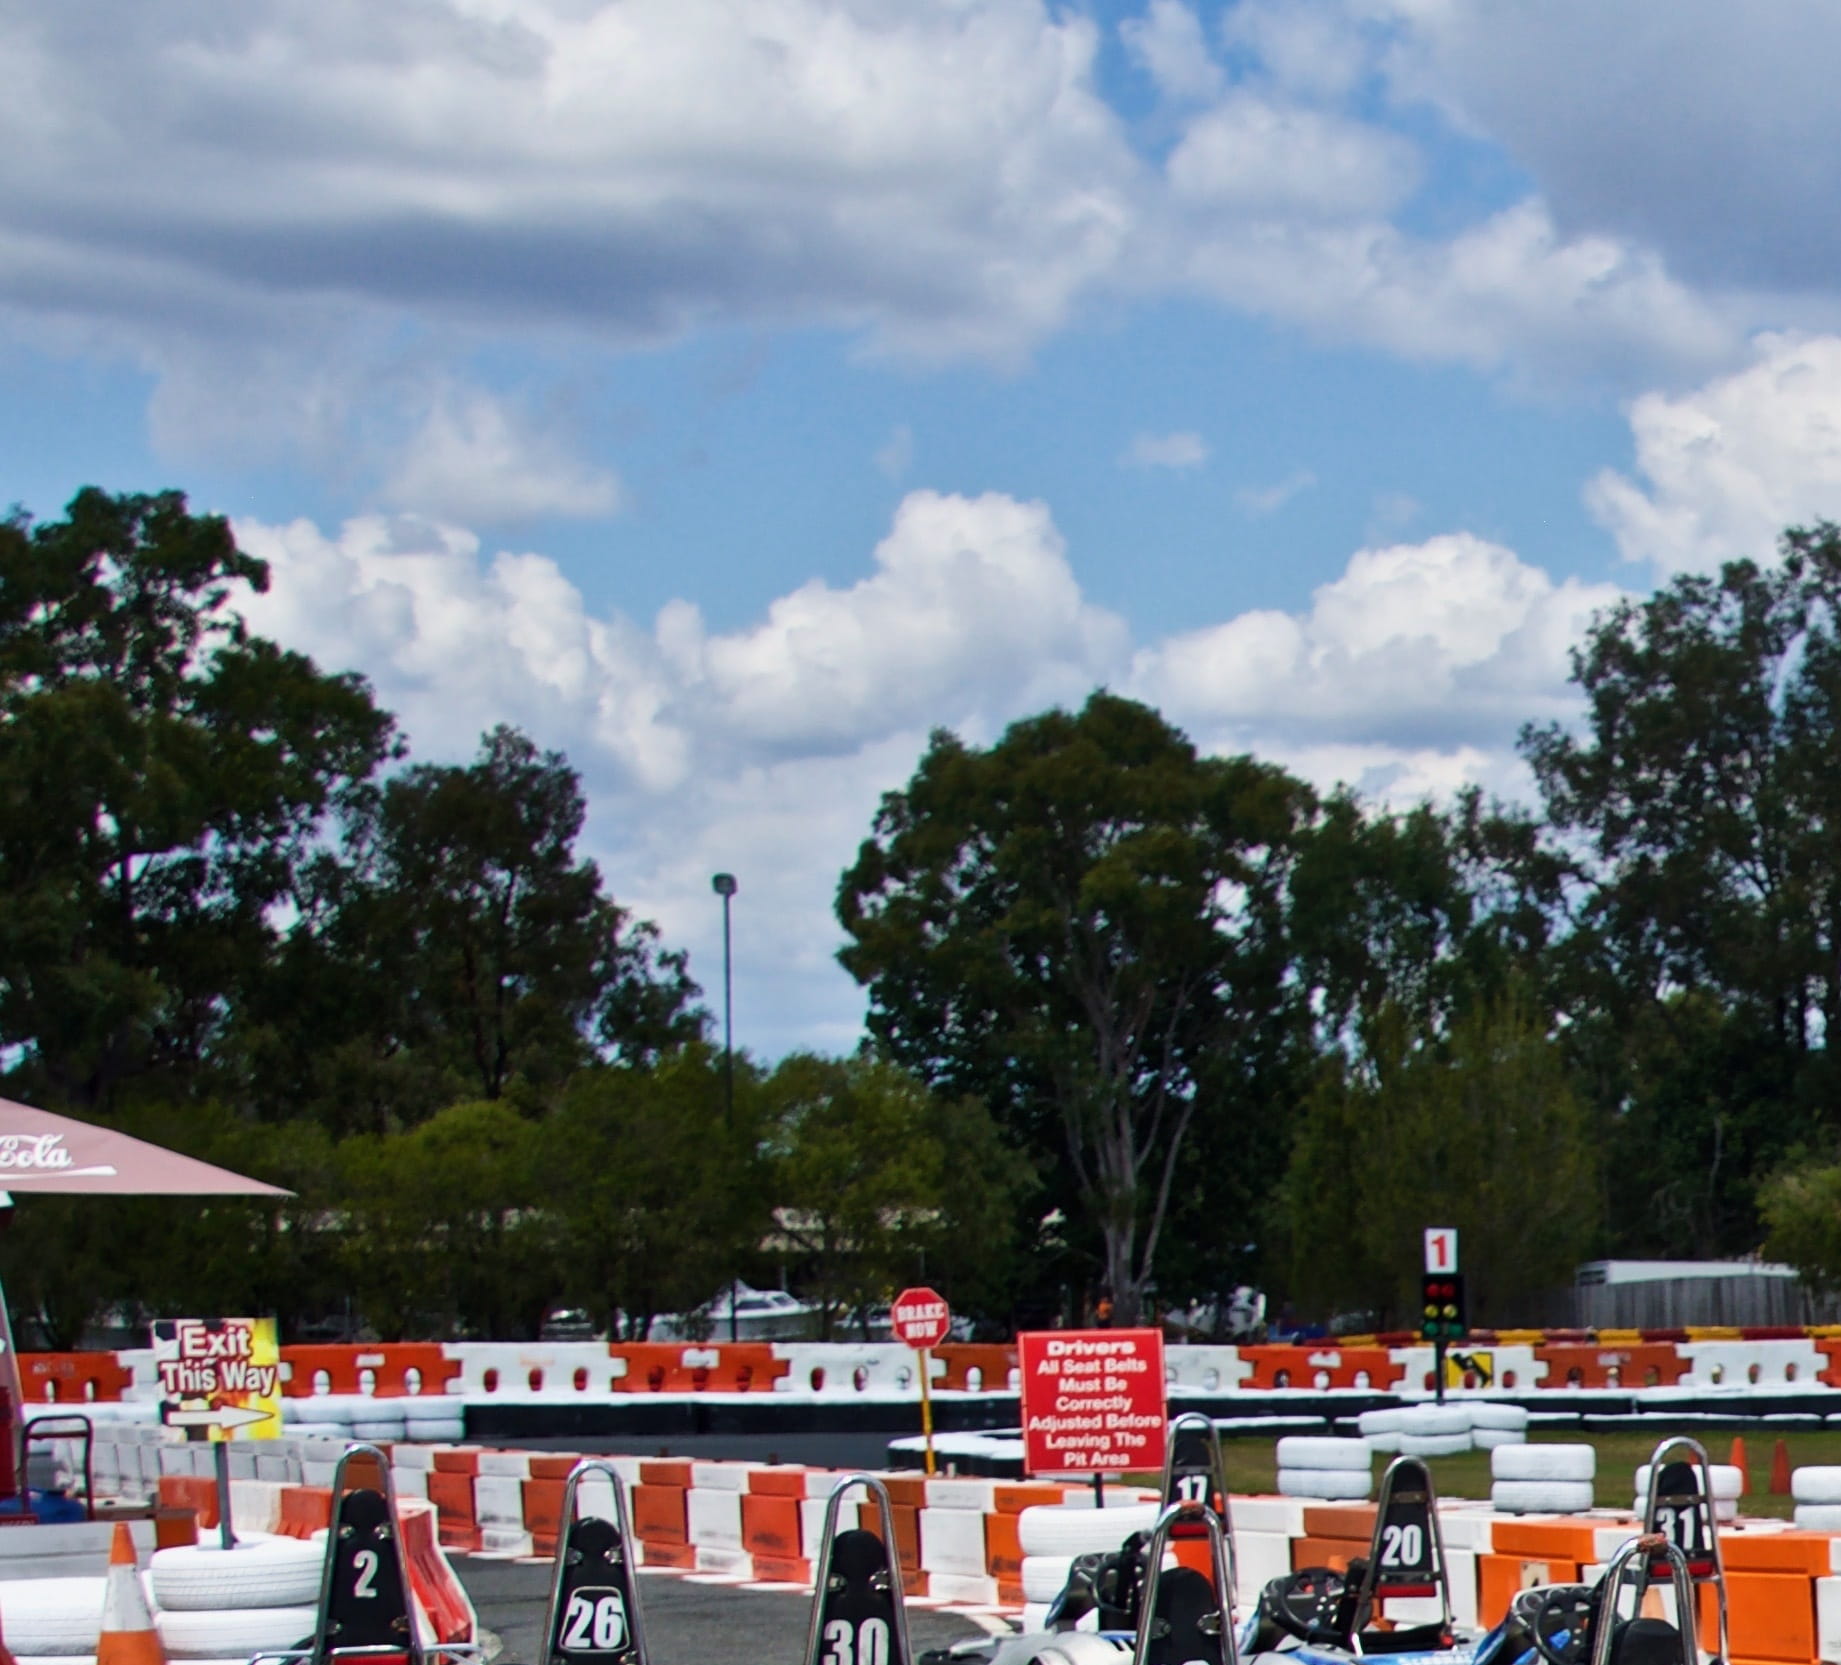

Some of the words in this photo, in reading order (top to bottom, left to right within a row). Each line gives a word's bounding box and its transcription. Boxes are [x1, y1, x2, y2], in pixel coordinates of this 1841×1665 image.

[1431, 1235, 1446, 1268] 1
[183, 1326, 252, 1357] Exit
[1047, 1340, 1136, 1356] Drivers
[161, 1361, 216, 1391] This
[221, 1361, 275, 1396] Way
[1037, 1360, 1059, 1374] All
[1063, 1359, 1101, 1374] Seat
[1104, 1358, 1147, 1373] Belts
[1059, 1378, 1101, 1393] Must
[1104, 1377, 1127, 1391] Be
[1056, 1396, 1132, 1412] Correctly
[1029, 1415, 1102, 1433] Adjusted
[1106, 1414, 1162, 1428] Before
[1046, 1433, 1110, 1450] Leaving
[1114, 1432, 1146, 1447] The
[1064, 1452, 1087, 1466] Pit
[1091, 1452, 1130, 1465] Area
[1177, 1475, 1208, 1503] 17
[1655, 1507, 1694, 1551] 31
[1381, 1524, 1422, 1569] 20
[354, 1550, 378, 1598] 2
[574, 1596, 616, 1649] 26
